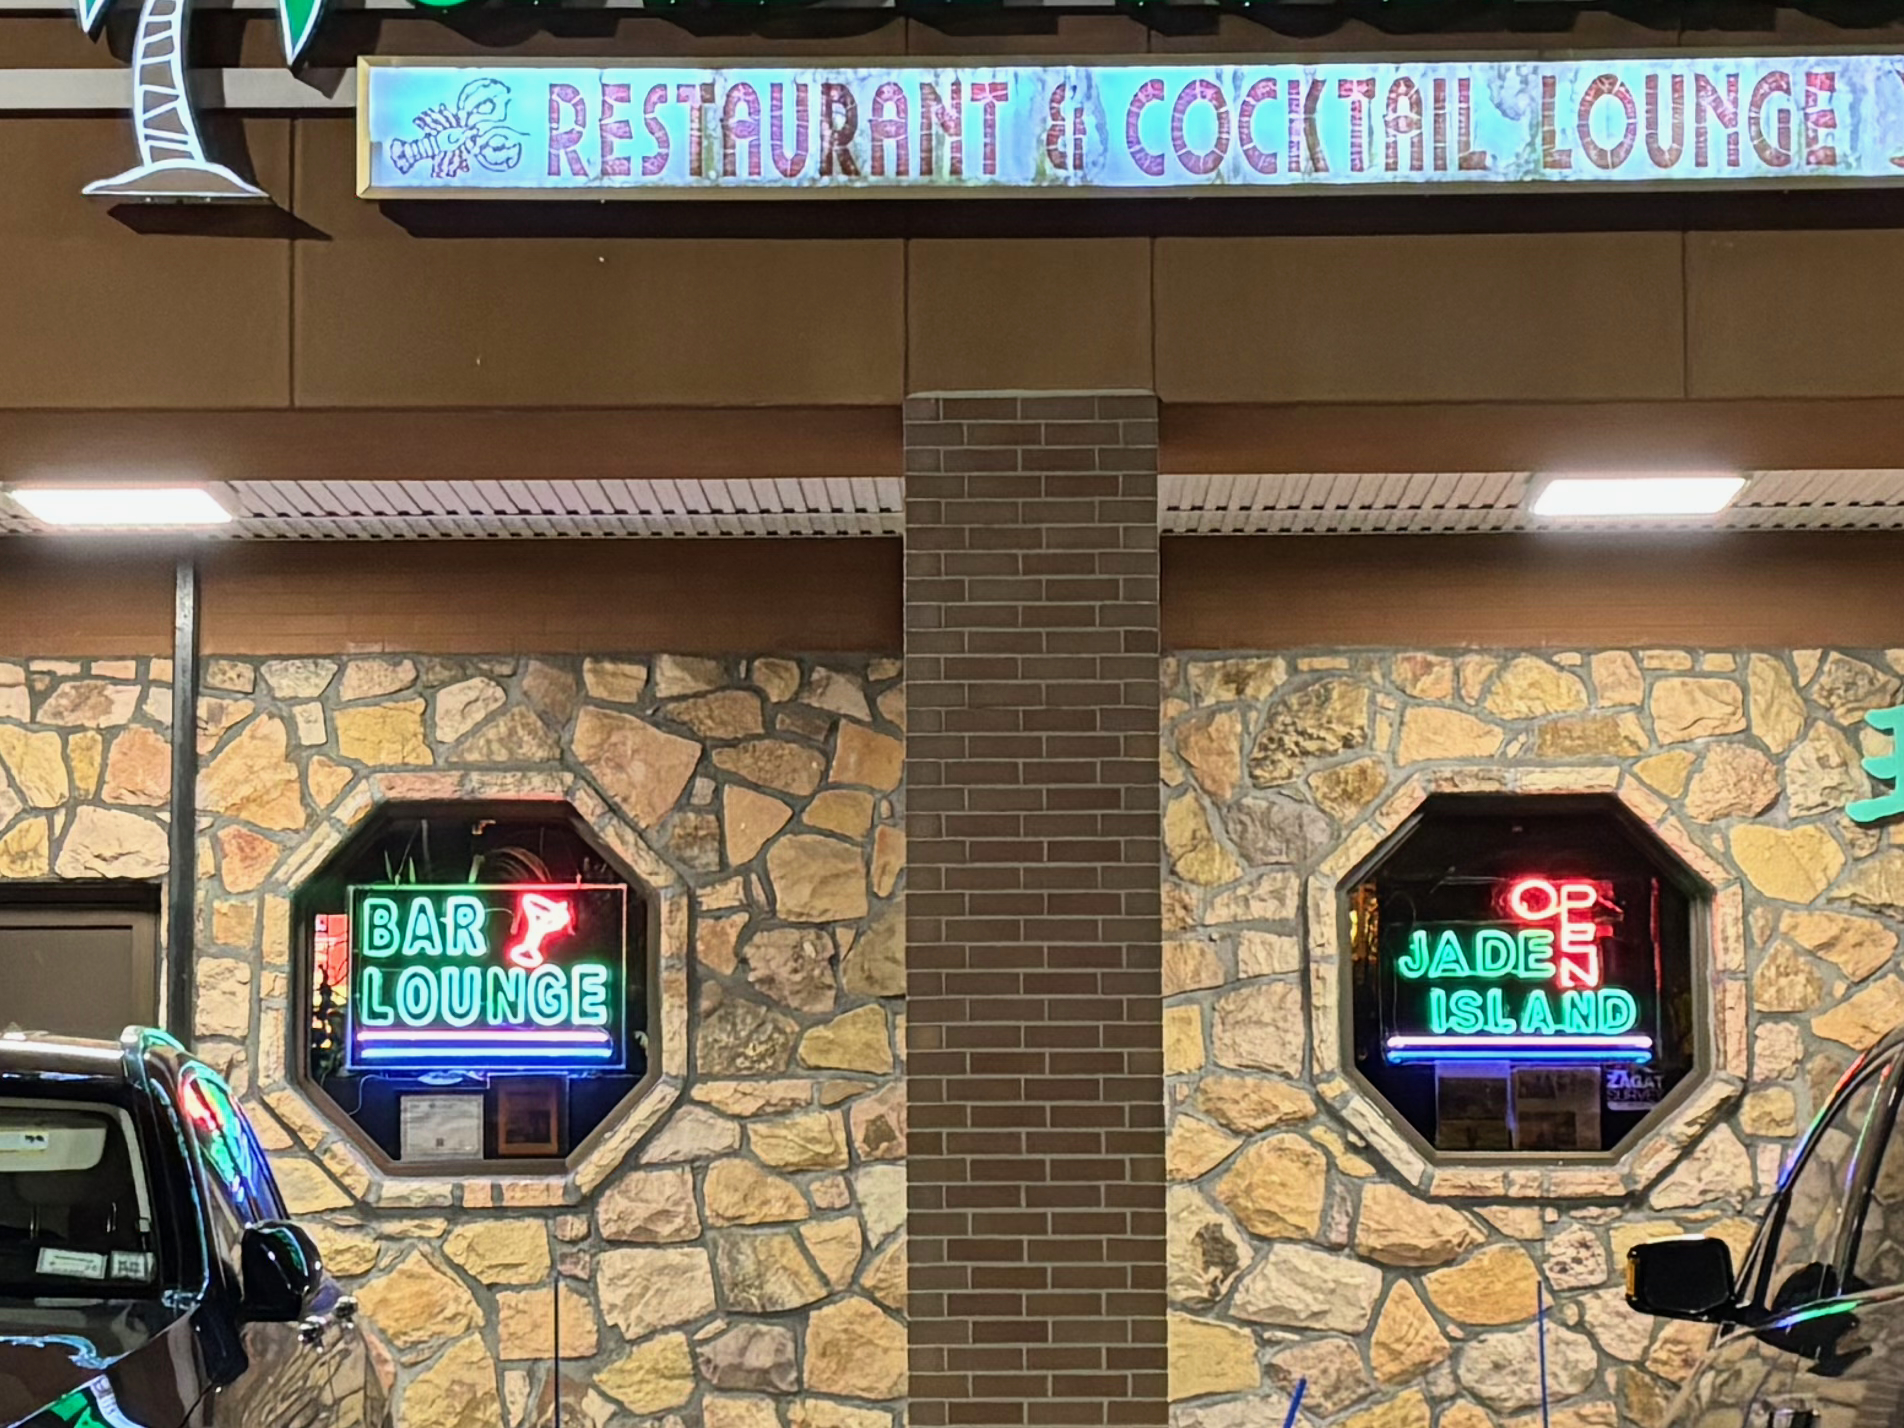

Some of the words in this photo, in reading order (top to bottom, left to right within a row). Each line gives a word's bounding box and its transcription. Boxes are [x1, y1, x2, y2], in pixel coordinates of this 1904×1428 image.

[546, 80, 1008, 178] RESTAURANT
[1125, 75, 1494, 176] COCKTAIL
[1541, 69, 1837, 169] LOUNGE
[361, 895, 487, 958] BAR
[1398, 928, 1558, 980] JADE
[1510, 878, 1601, 988] OPEN
[361, 963, 608, 1028] LOUNGE
[1429, 986, 1638, 1035] ISLAND
[1605, 1069, 1665, 1090] ZAGAT
